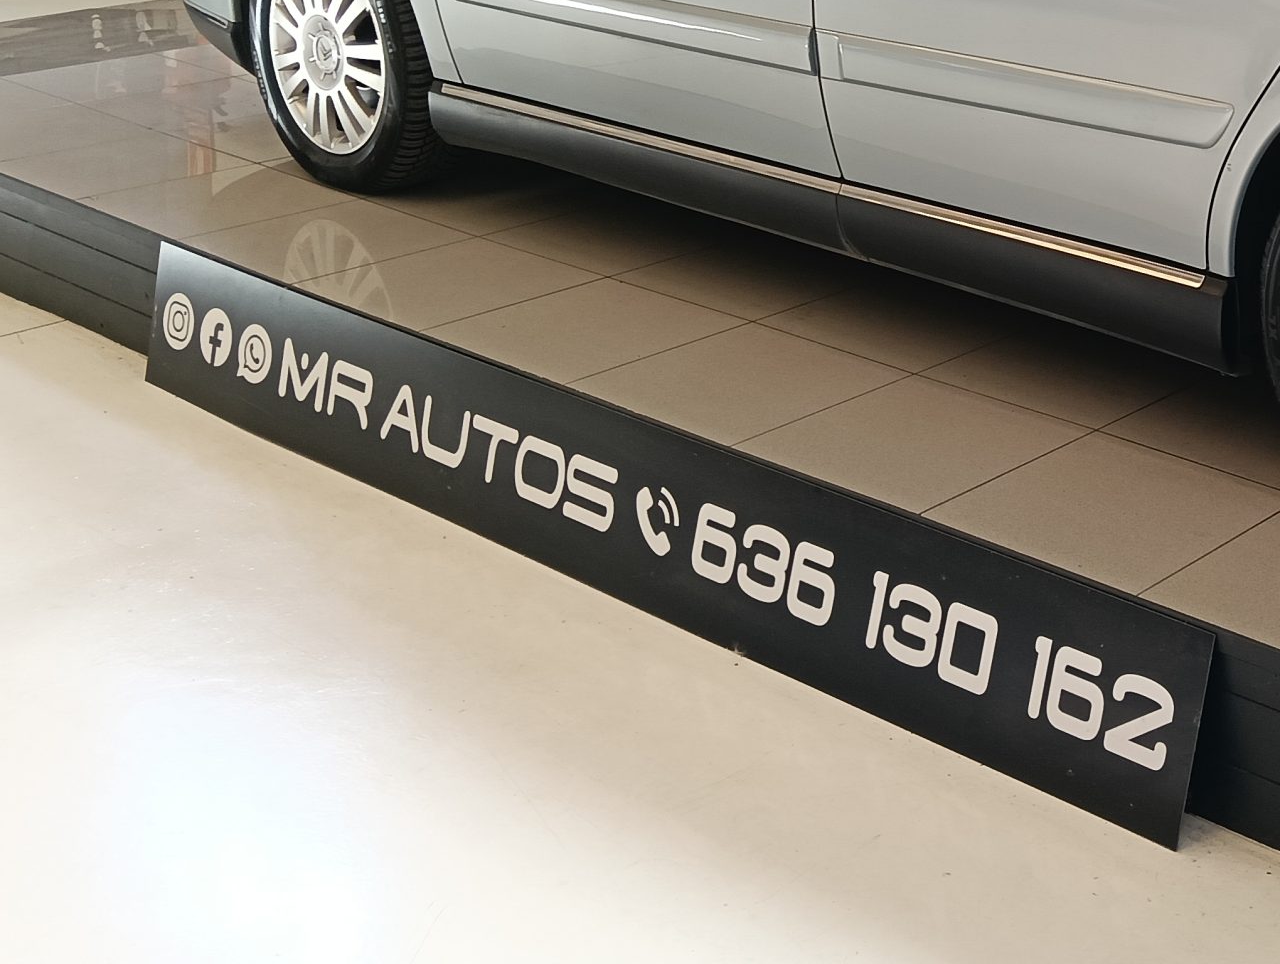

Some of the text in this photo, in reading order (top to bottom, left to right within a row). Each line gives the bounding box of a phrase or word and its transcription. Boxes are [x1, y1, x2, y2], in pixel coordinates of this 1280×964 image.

[278, 337, 1175, 771] MR AUTOS 636 130 162
